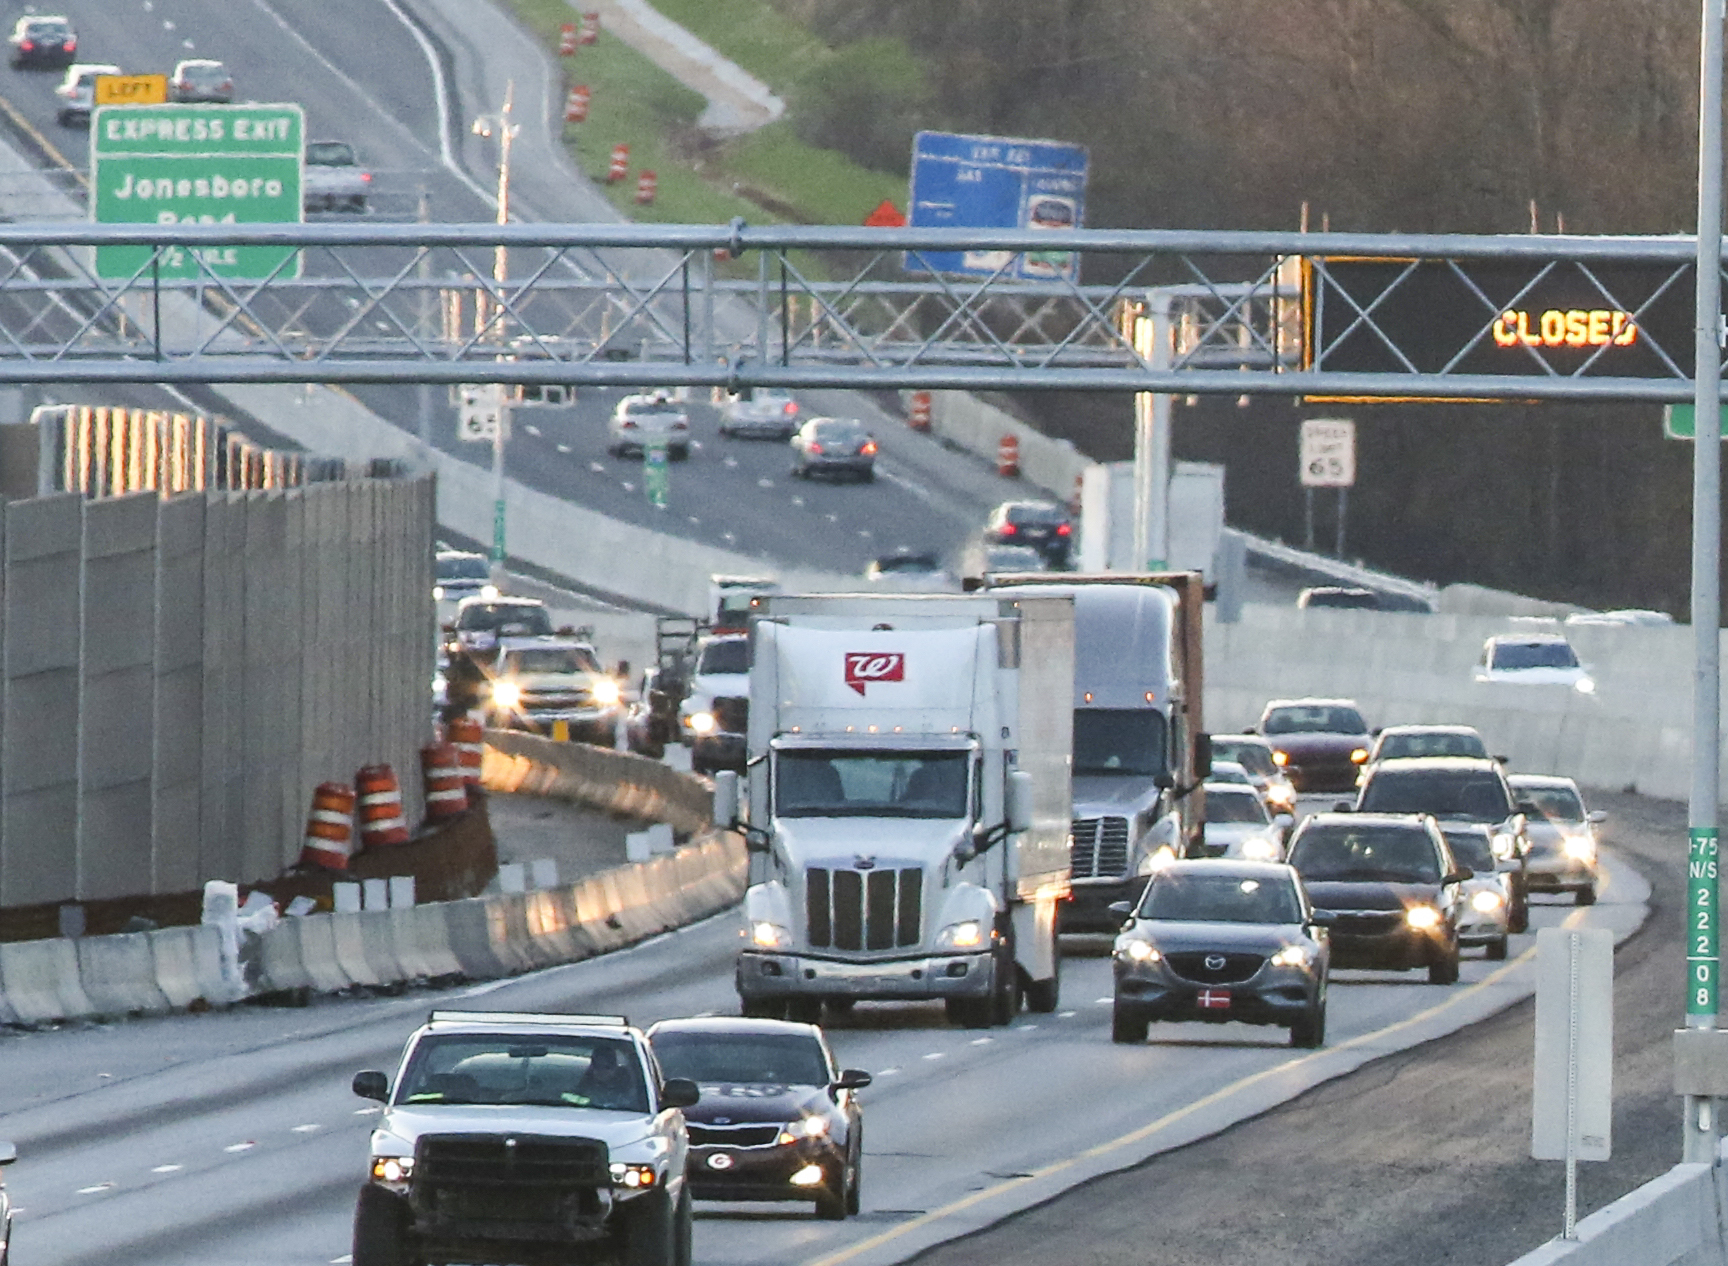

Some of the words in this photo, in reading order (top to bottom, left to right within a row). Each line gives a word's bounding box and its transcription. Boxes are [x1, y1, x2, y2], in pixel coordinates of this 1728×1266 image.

[108, 83, 152, 97] LEFT
[106, 118, 224, 141] EXPRESS
[233, 118, 290, 141] EXIT
[114, 173, 283, 199] Jonesboro
[1493, 310, 1637, 346] CLOSED
[1688, 837, 1718, 856] I-75
[1689, 860, 1718, 879] N/S
